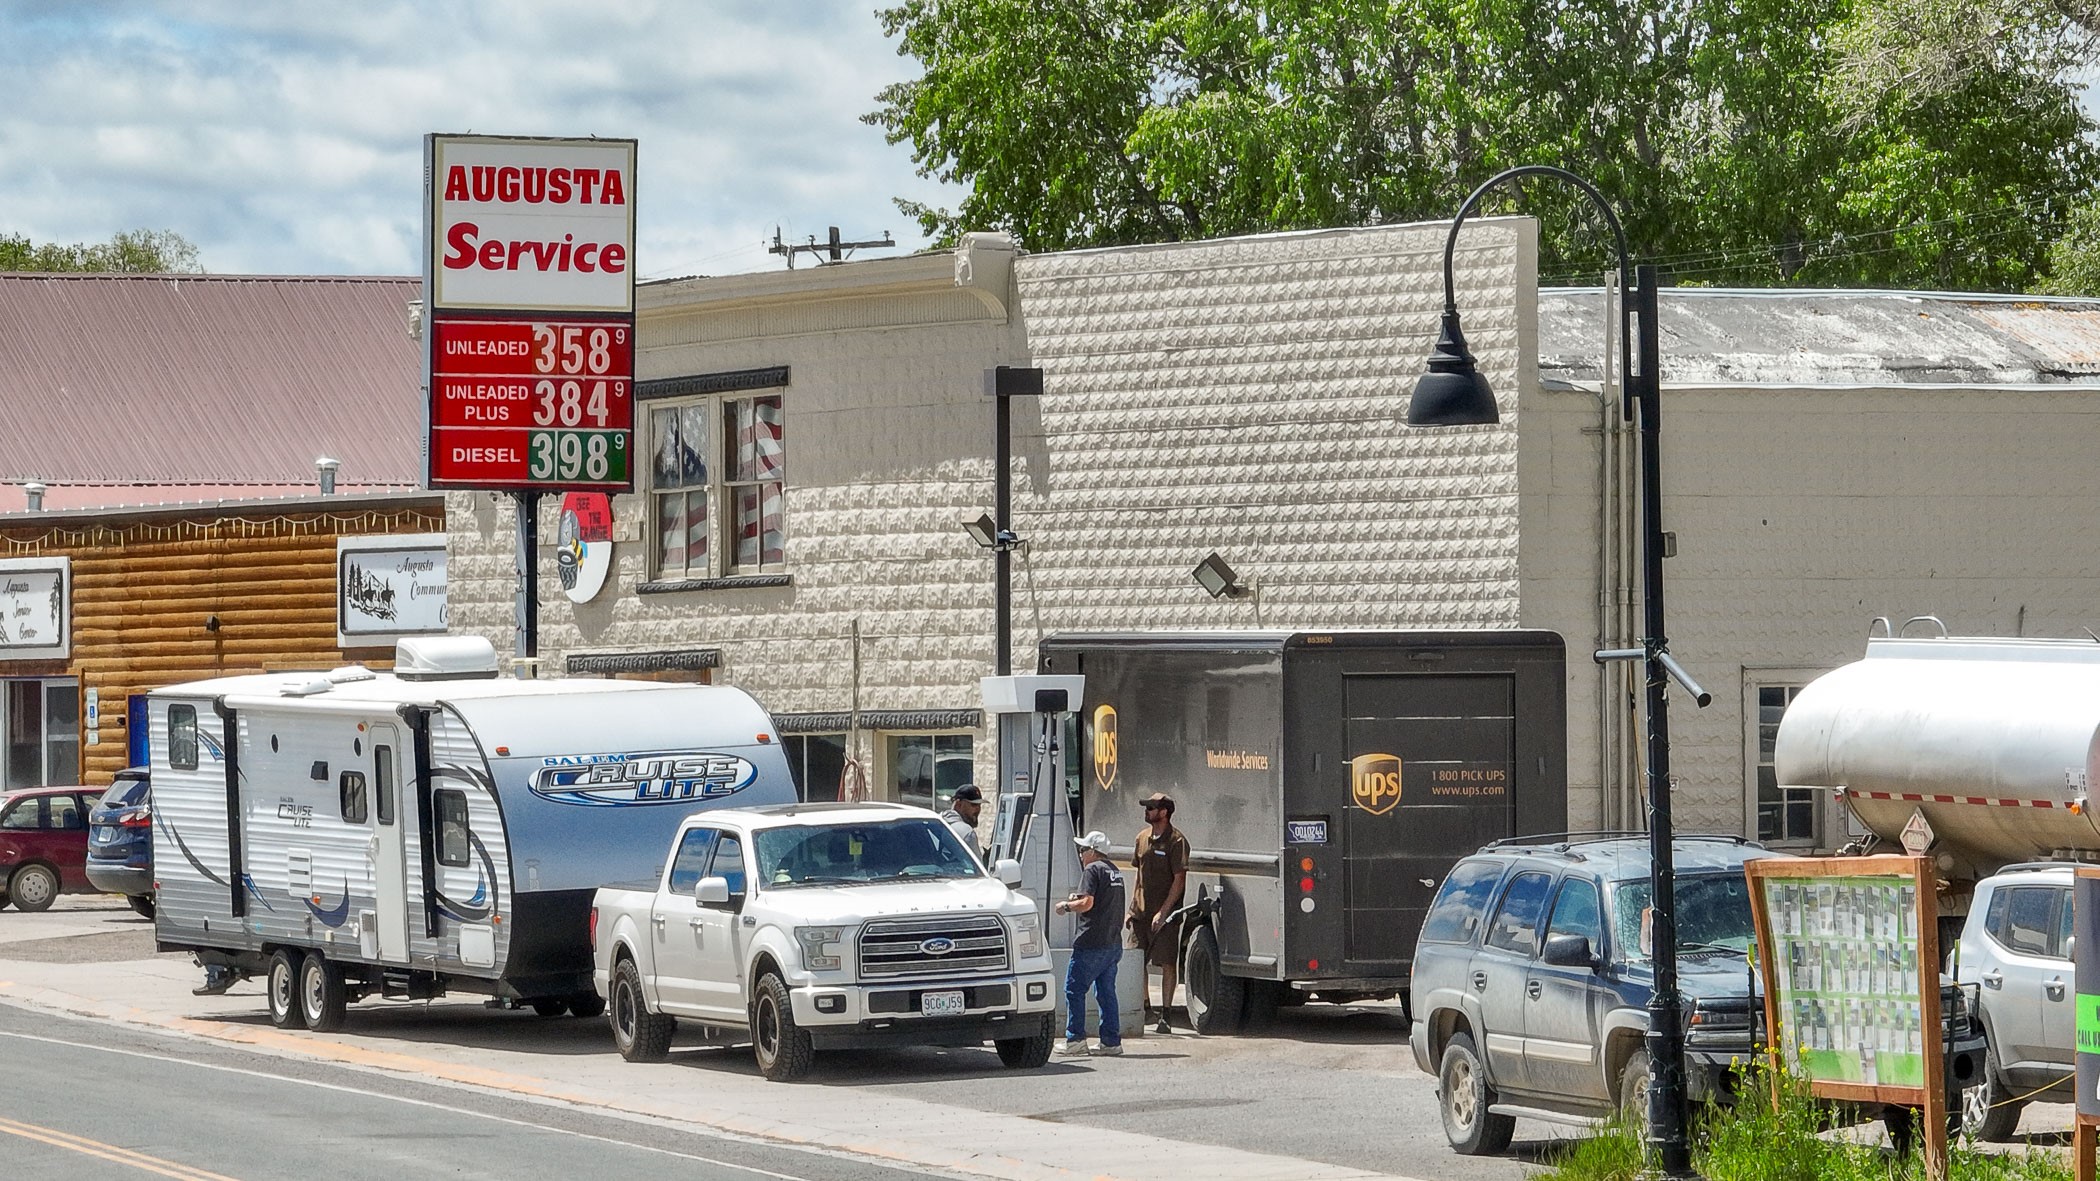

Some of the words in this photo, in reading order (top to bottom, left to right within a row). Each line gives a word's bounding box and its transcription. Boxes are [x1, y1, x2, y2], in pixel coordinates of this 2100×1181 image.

[445, 165, 625, 205] AUGUSTA
[443, 221, 626, 274] Service
[446, 340, 529, 356] UNLEADED
[534, 327, 611, 374] 358
[445, 385, 529, 400] UNLEADED
[533, 379, 609, 427] 384
[464, 406, 509, 421] PLUS
[452, 448, 521, 463] DIESEL
[531, 432, 609, 479] 398
[396, 556, 434, 578] Augusta
[12, 599, 32, 618] Senior
[544, 754, 626, 767] SALEM
[1095, 731, 1115, 776] ups
[1206, 750, 1241, 769] Worldwide
[1241, 751, 1268, 770] Services
[536, 758, 738, 792] CRUISE
[1439, 771, 1458, 781] 800
[1461, 770, 1483, 781] PICK
[1486, 770, 1505, 781] UPS
[635, 776, 735, 800] LITE
[1356, 772, 1399, 806] ups
[1431, 786, 1505, 798] www.ups.com
[277, 804, 313, 820] CRUISE
[293, 817, 313, 829] LITE
[929, 942, 948, 951] Ford
[2077, 1029, 2091, 1047] CALL
